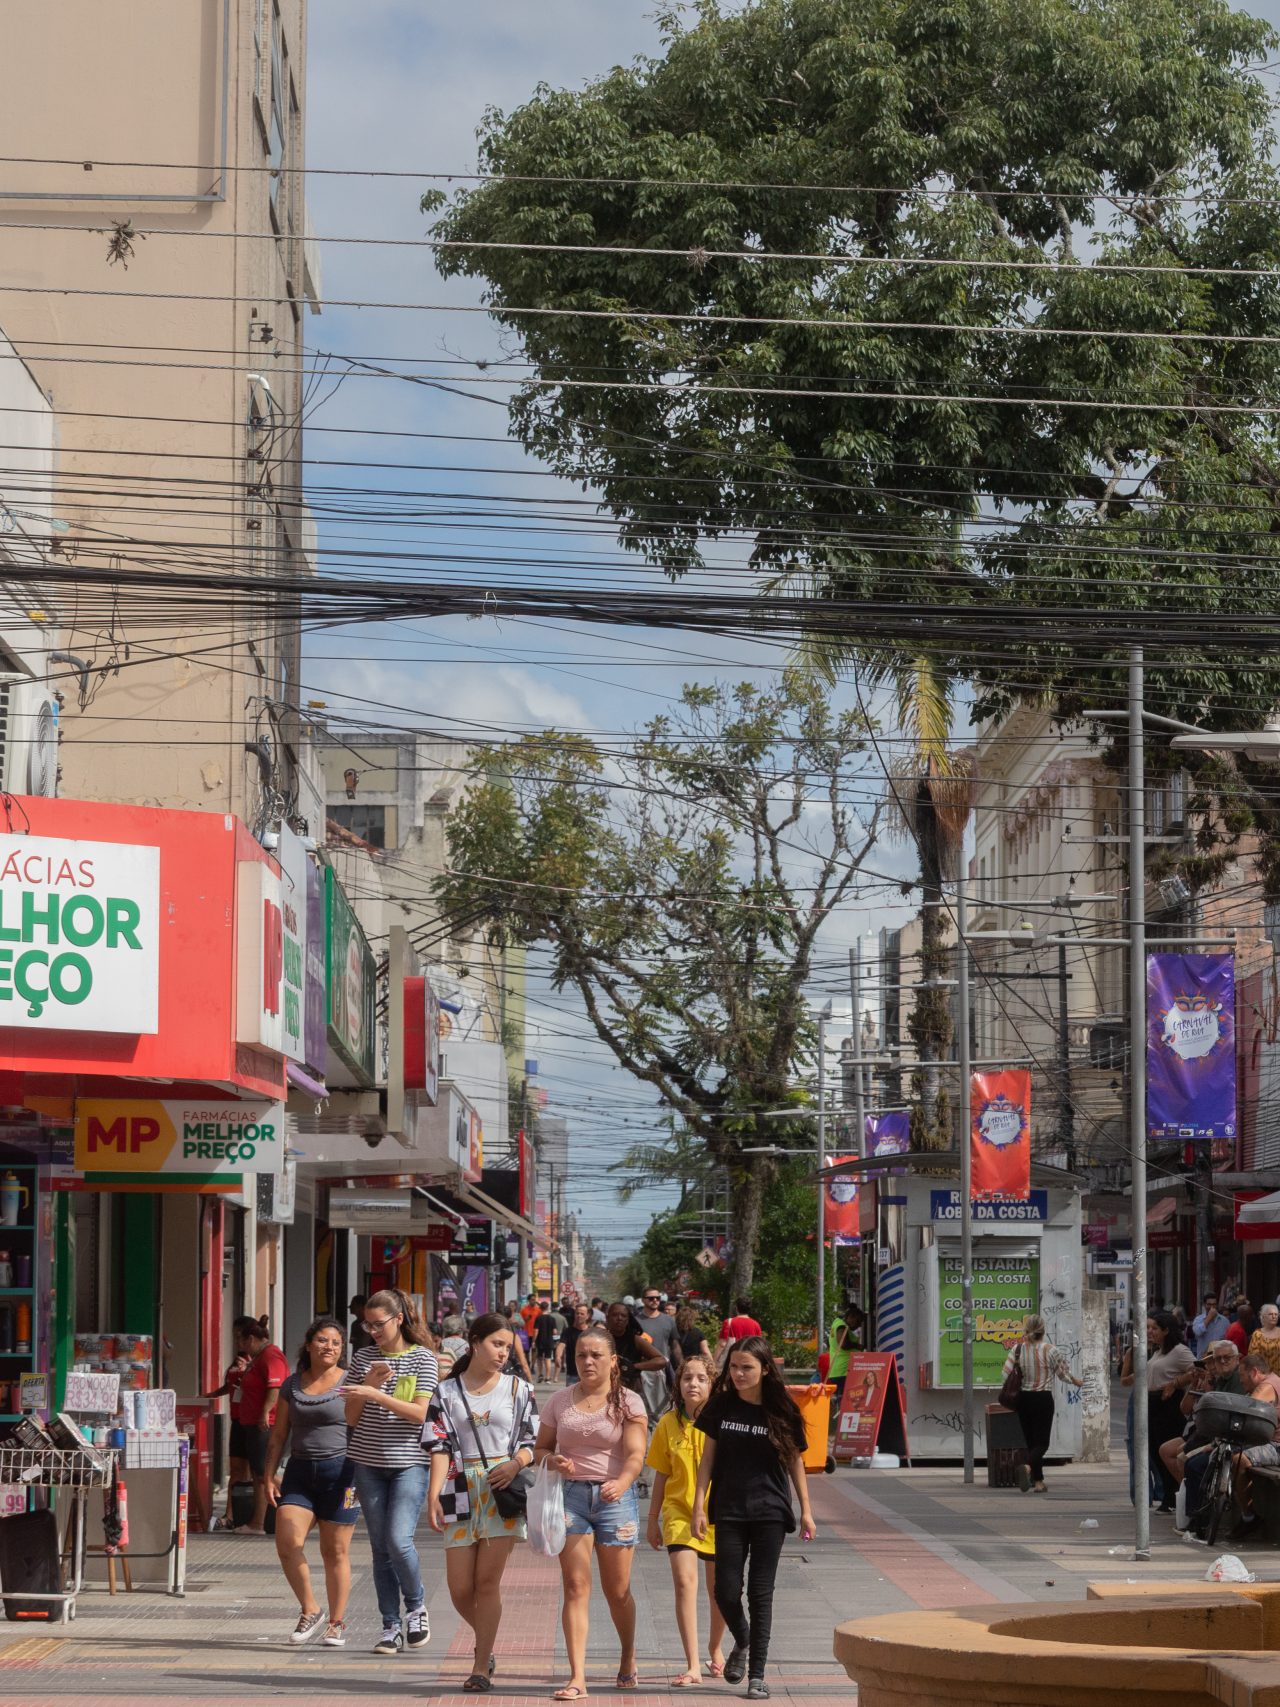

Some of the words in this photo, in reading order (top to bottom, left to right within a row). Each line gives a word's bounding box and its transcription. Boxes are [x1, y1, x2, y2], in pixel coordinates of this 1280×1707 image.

[1173, 1014, 1212, 1031] CARNAVAL
[183, 1111, 256, 1122] FARMÁCIAS
[87, 1117, 160, 1153] MP
[183, 1124, 275, 1141] MELHOR
[183, 1143, 256, 1164] PREÇO
[938, 1206, 973, 1219] LOB
[978, 1206, 995, 1219] DA
[999, 1206, 1040, 1219] COSTA
[945, 1259, 1031, 1271] REISTARIA
[979, 1275, 993, 1283] DA
[998, 1275, 1031, 1283] COSTA
[944, 1299, 997, 1309] COPRE
[1000, 1299, 1032, 1309] AQUI
[67, 1375, 118, 1394] PROMOÇÃO
[721, 1419, 750, 1433] drama
